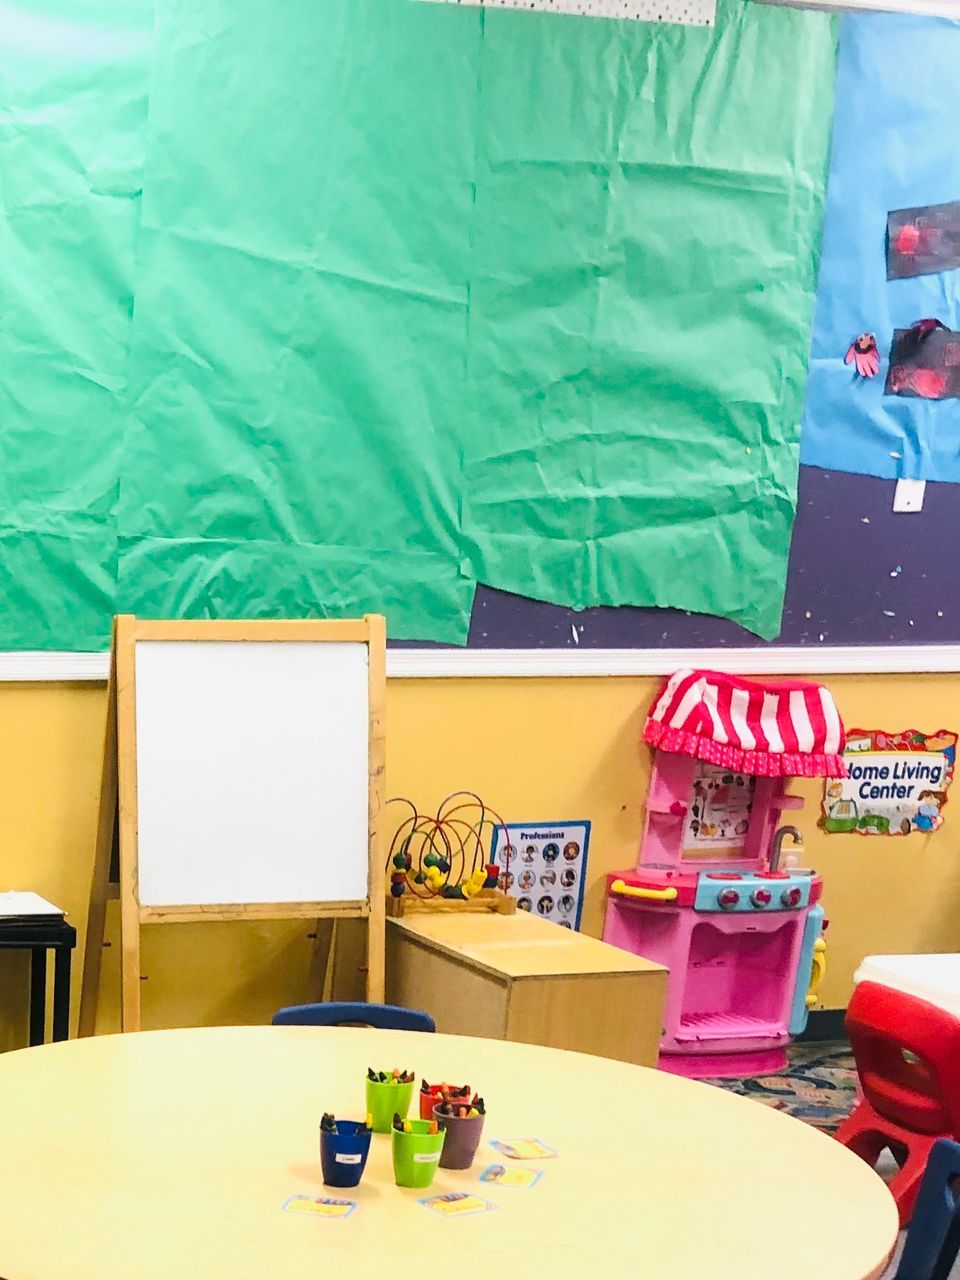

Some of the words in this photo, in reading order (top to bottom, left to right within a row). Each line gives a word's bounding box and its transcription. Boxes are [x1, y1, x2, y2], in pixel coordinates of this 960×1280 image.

[893, 761, 942, 784] Living
[859, 782, 915, 799] Center
[520, 830, 565, 840] Professions
